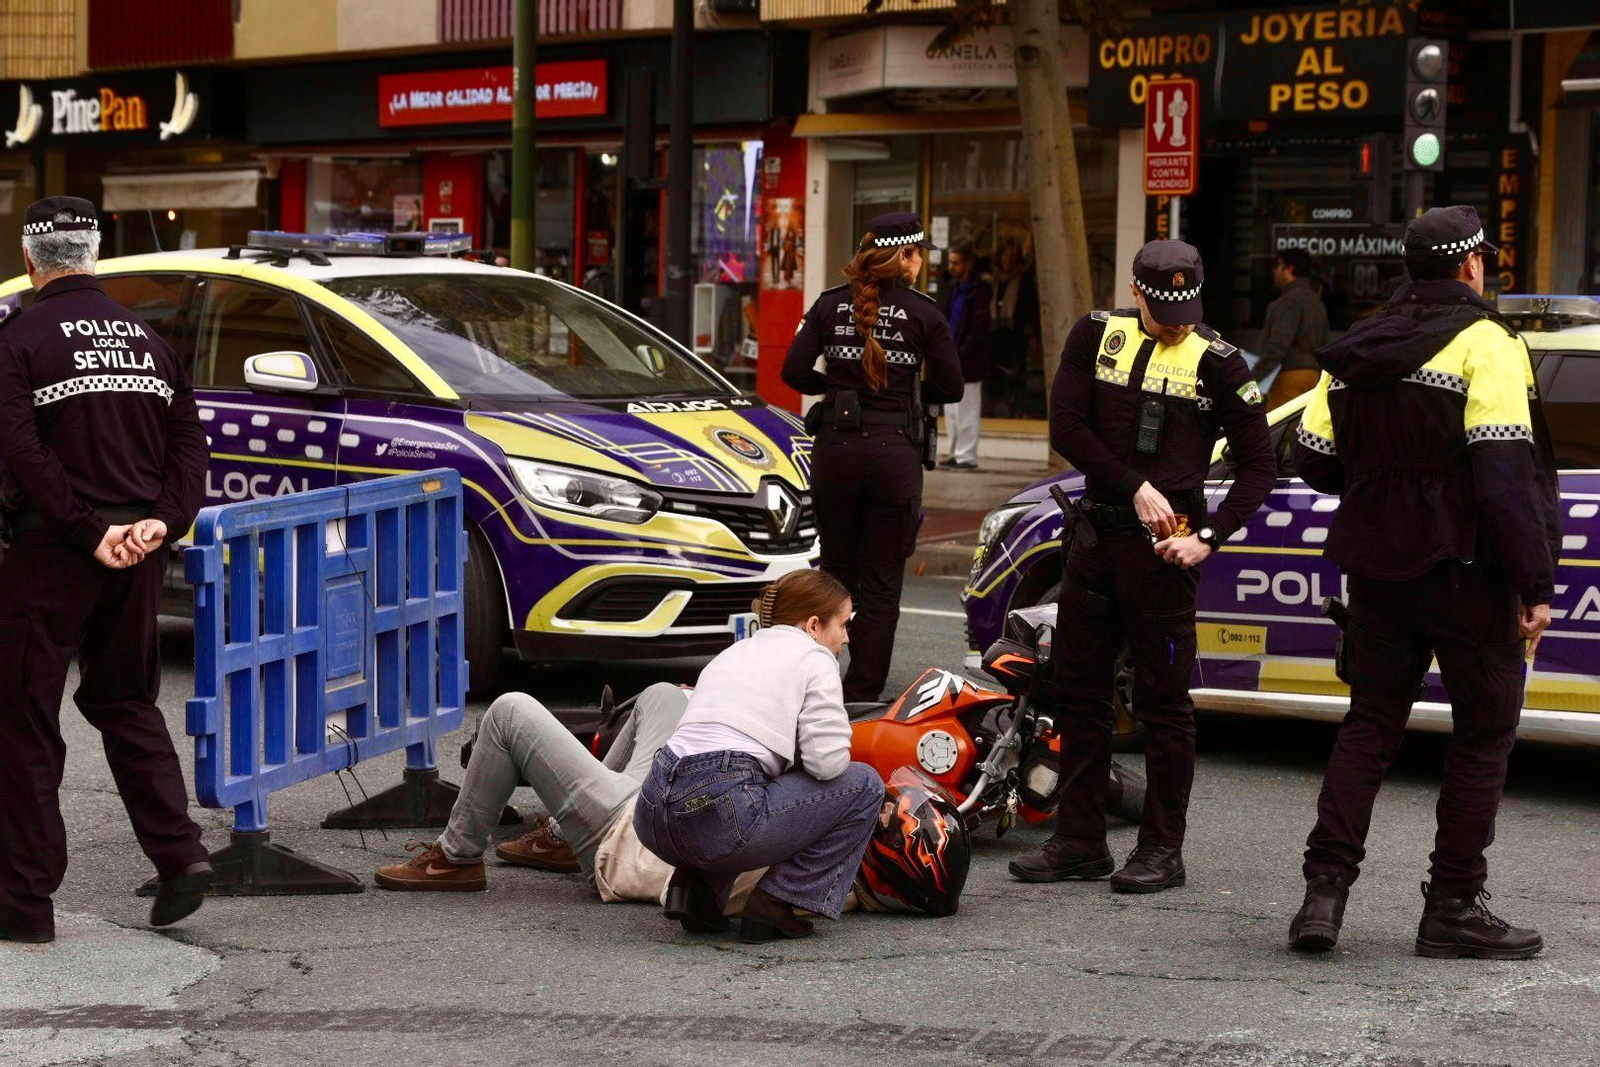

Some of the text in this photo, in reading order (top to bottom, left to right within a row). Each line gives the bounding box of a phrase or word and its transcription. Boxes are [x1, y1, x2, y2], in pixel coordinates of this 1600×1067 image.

[1240, 6, 1405, 45] JOYERIA
[1099, 33, 1211, 69] COMPRO
[1295, 46, 1344, 76] AL
[410, 90, 444, 110] MEJOR
[446, 87, 494, 107] CALIDAD
[497, 86, 513, 104] AL
[1270, 79, 1370, 112] PESO
[51, 87, 147, 134] PinePan
[1148, 157, 1188, 167] HIDRANTE
[1152, 168, 1185, 178] CONTRA
[1147, 178, 1189, 188] INCENDIOS
[1312, 207, 1353, 219] COMPRO
[60, 319, 149, 340] POLICIA
[849, 316, 892, 327] LAL
[835, 325, 904, 342] SELLA
[93, 338, 130, 349] LOCAL
[74, 350, 156, 371] SEVILLA
[1149, 362, 1196, 379] POLICIA
[391, 437, 460, 452] @EmergenciasSev
[1230, 633, 1243, 642] 092
[1248, 634, 1261, 643] 112
